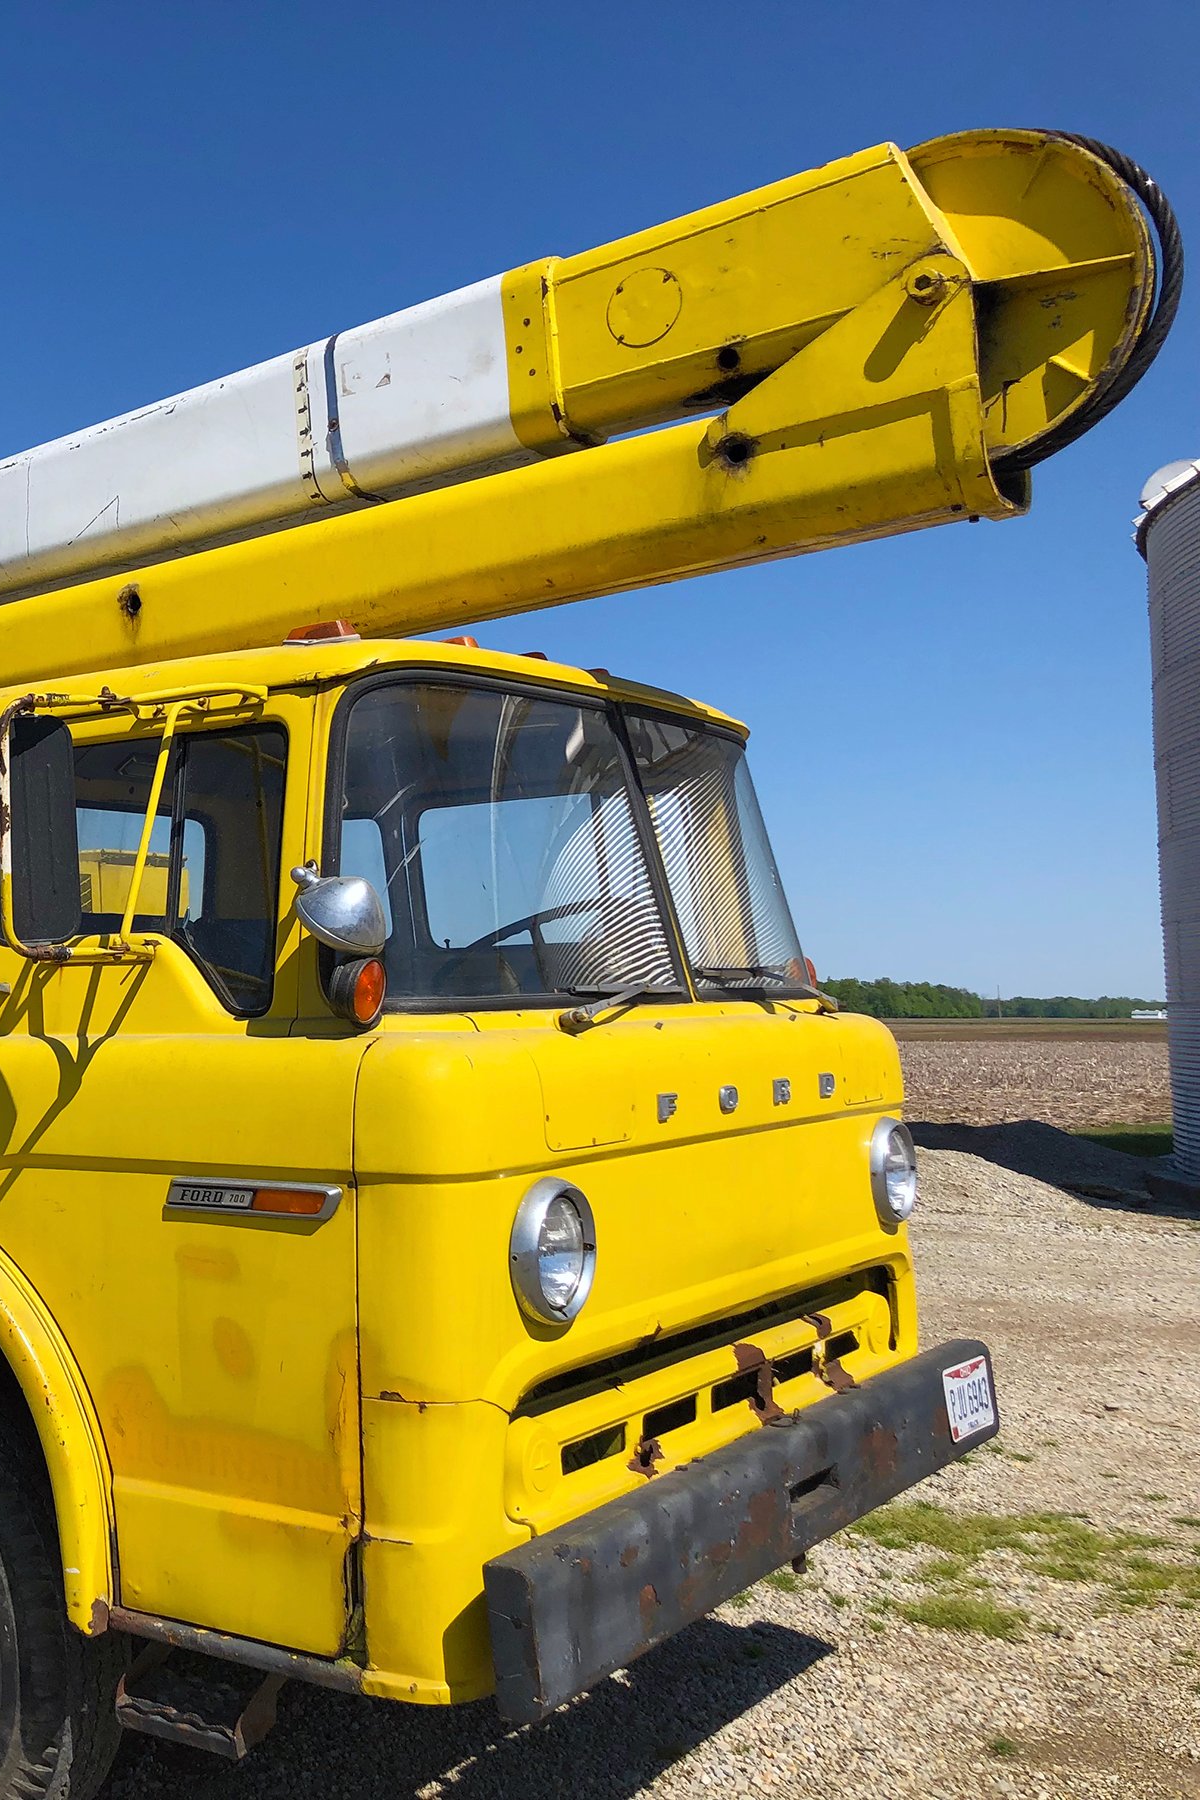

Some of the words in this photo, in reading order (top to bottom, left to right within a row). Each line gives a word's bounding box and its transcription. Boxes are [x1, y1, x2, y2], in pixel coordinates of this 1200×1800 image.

[656, 1072, 836, 1124] FORD
[179, 1189, 224, 1204] FORD
[229, 1193, 246, 1204] 700
